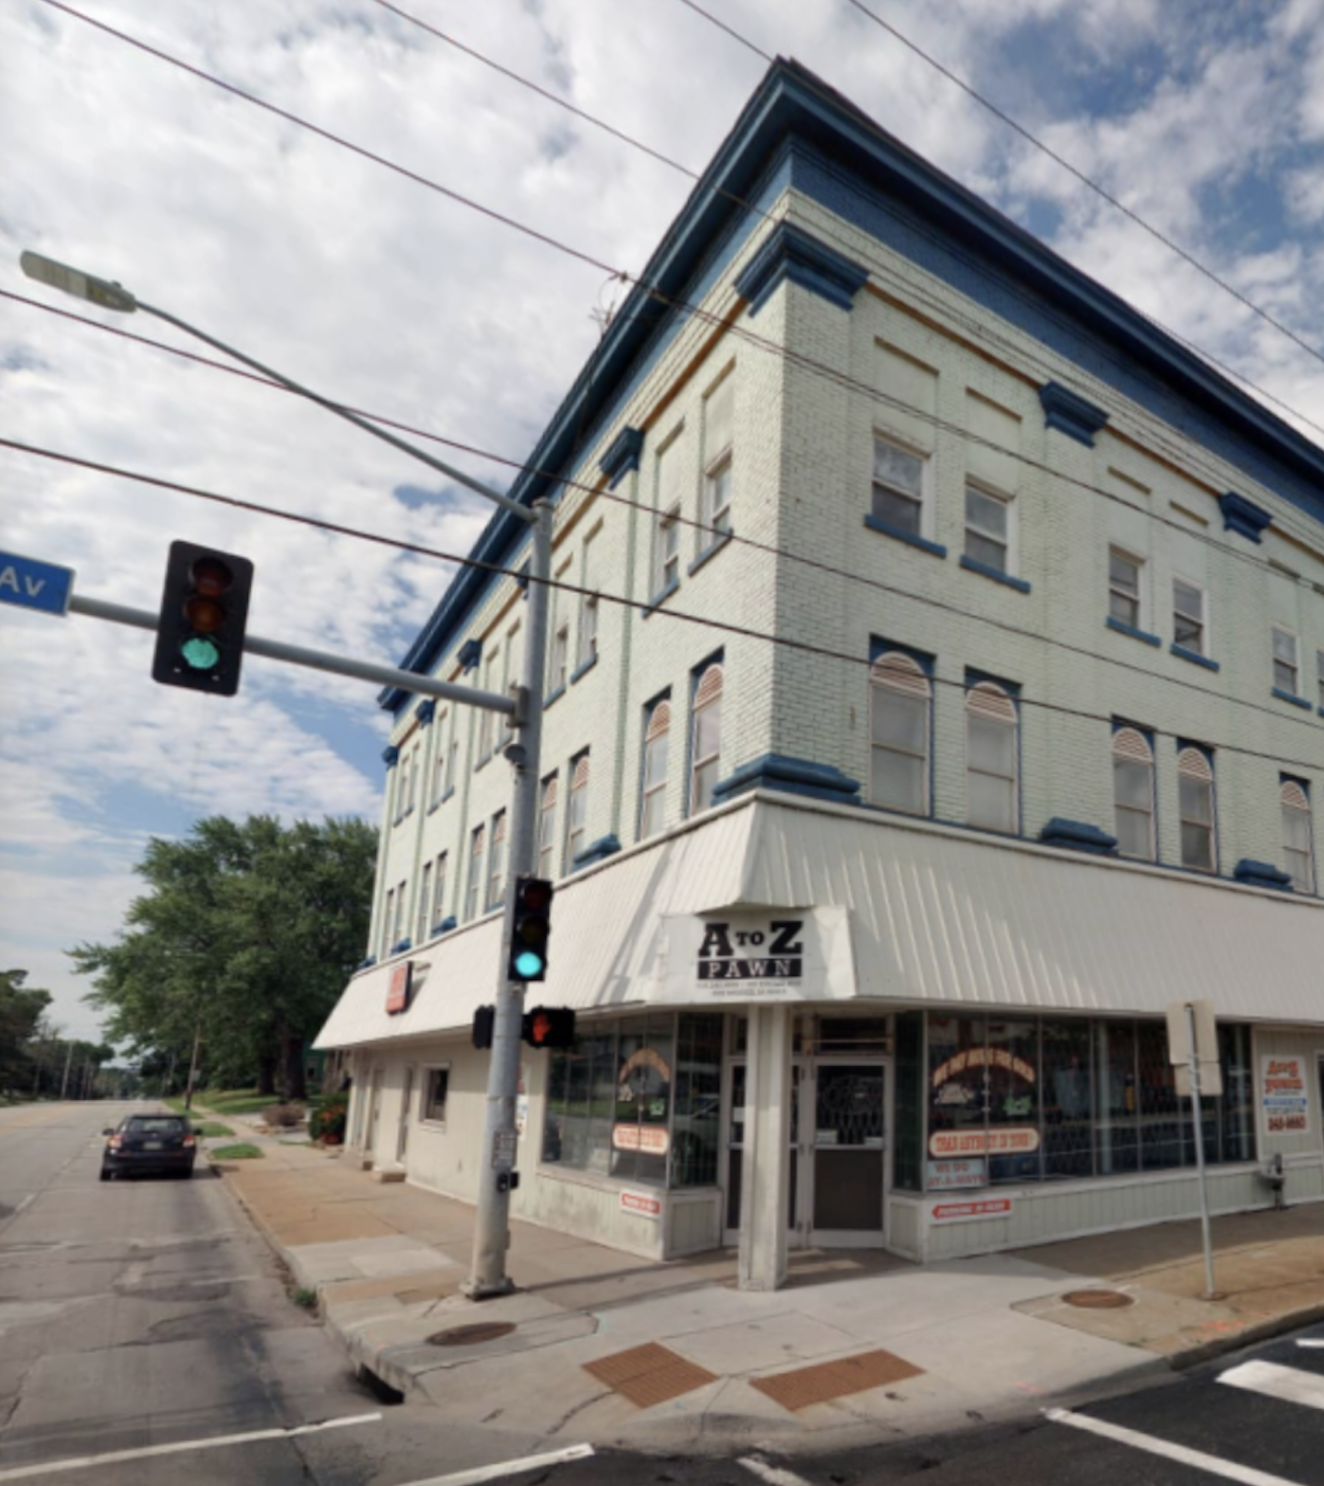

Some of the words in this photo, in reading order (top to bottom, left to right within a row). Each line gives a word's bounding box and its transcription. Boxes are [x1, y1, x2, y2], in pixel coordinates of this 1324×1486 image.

[0, 566, 46, 597] Av
[699, 922, 735, 957] A
[769, 921, 803, 955] Z
[708, 960, 791, 978] PAWN
